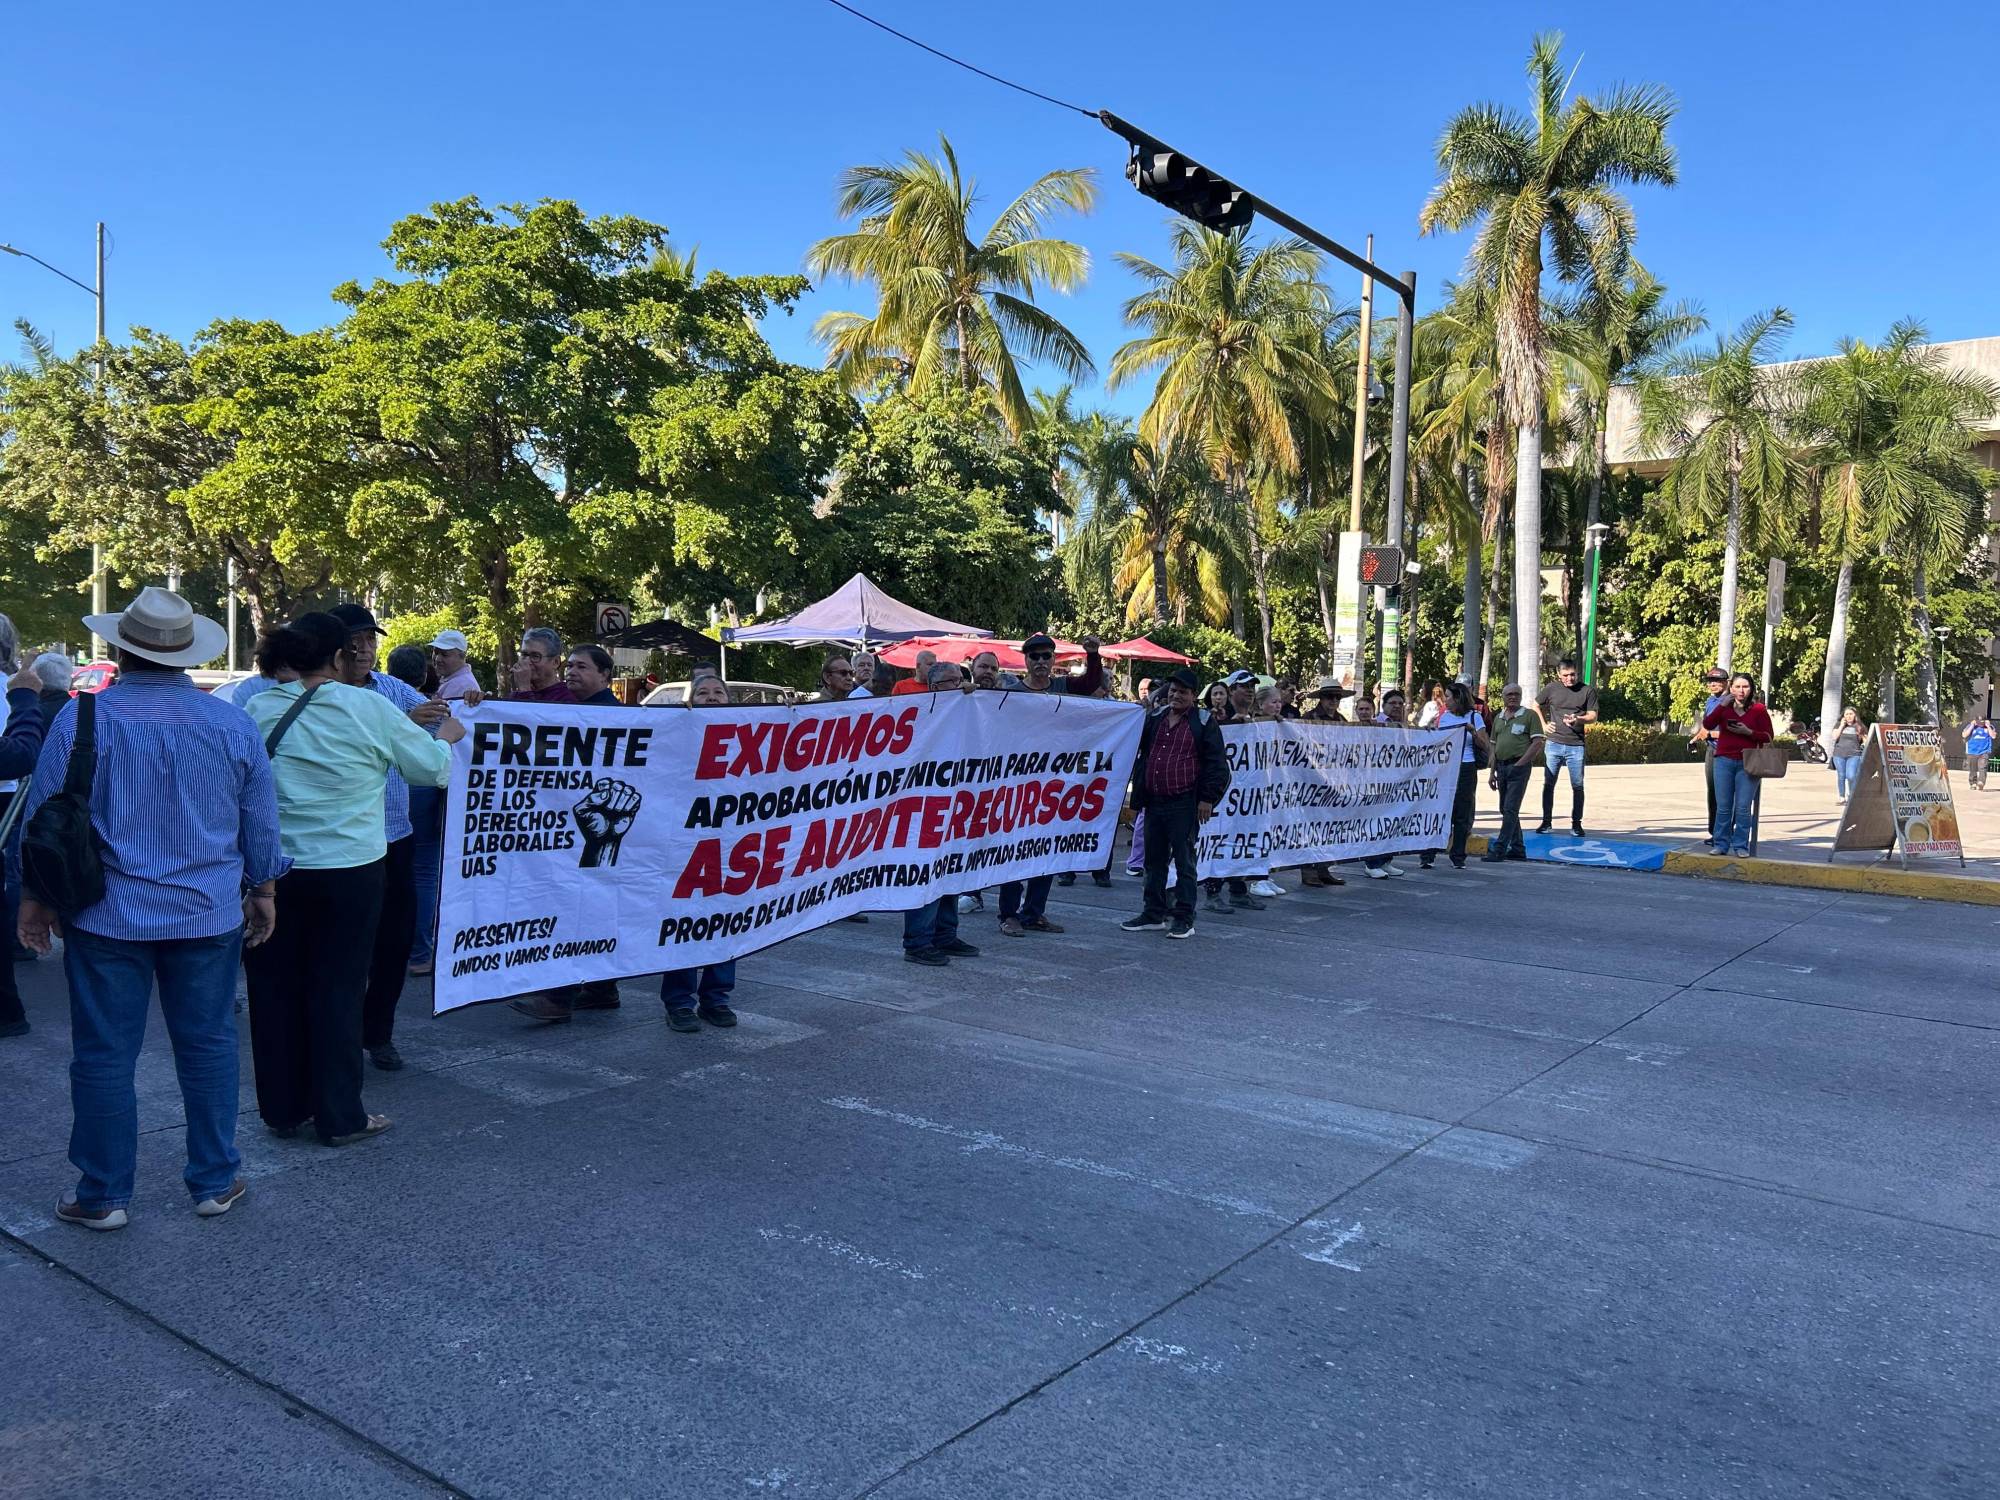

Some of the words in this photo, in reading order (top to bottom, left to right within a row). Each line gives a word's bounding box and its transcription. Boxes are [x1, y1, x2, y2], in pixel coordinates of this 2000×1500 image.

[471, 723, 654, 767] FRENTE
[695, 707, 917, 780] EXIGIMOS
[1886, 731, 1895, 745] SE
[1895, 731, 1919, 746] VENDE
[1225, 742, 1250, 771] RA
[1371, 743, 1395, 769] LOS
[468, 769, 497, 789] DE
[503, 770, 594, 790] DEFENSA
[684, 768, 873, 829] APROBACIÓN
[874, 767, 905, 799] DE
[903, 754, 1004, 789] INICIATIVA
[1004, 751, 1051, 778] PARA
[1050, 750, 1090, 775] QUE
[1093, 751, 1115, 772] LA
[466, 791, 495, 811] DE
[501, 789, 537, 811] LOS
[1917, 793, 1950, 804] MANTEQUILLA
[464, 810, 569, 834] DERECHOS
[463, 830, 576, 857] LABORALES
[672, 825, 792, 898] ASE
[791, 796, 952, 878] AUDITE
[944, 777, 1109, 843] RECURSOS
[1231, 832, 1258, 860] DE
[461, 855, 497, 879] UAS
[658, 906, 755, 946] PROPIOS
[754, 898, 778, 929] DE
[776, 893, 796, 920] LA
[796, 881, 826, 912] UAS,
[828, 863, 931, 901] PRESENTADA
[947, 852, 964, 875] EL
[964, 843, 1015, 873] DIPUTADO
[1015, 836, 1051, 861] SERGIO
[1054, 833, 1099, 854] TORRES
[453, 916, 558, 954] PRESENTES!
[452, 953, 501, 978] UNIDOS
[505, 944, 550, 968] VAMOS
[552, 937, 617, 960] GANANDO
